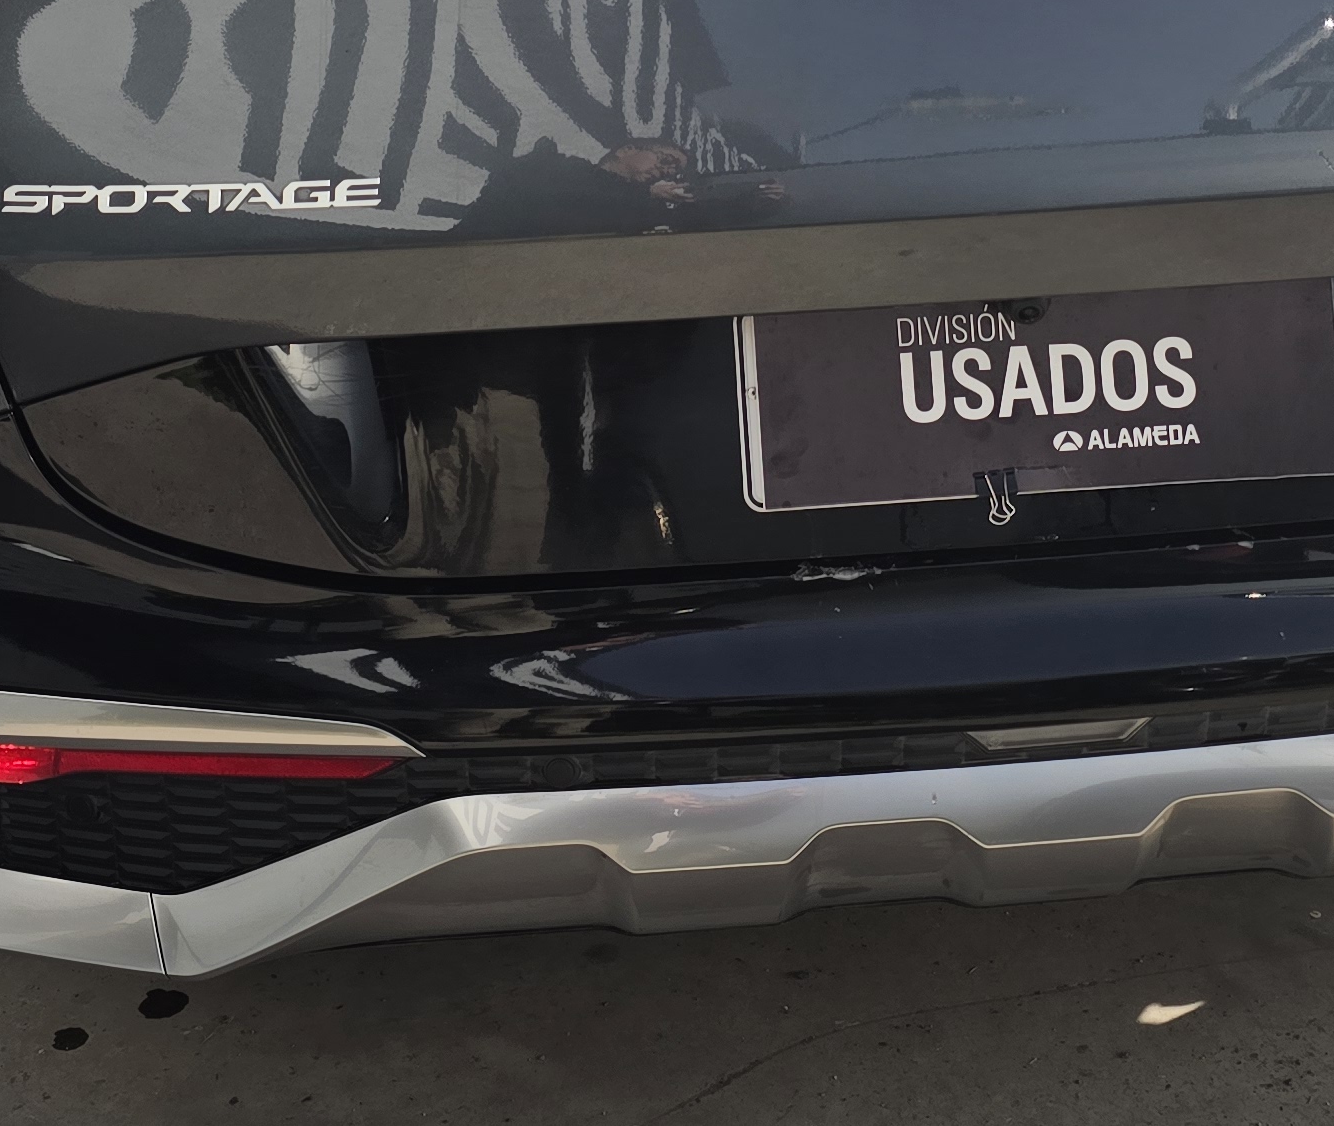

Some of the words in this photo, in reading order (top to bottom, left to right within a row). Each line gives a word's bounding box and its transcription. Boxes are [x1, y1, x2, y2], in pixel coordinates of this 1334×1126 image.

[1, 177, 382, 216] SPORTAGE
[896, 304, 1016, 347] DIVISIÓN
[899, 336, 1197, 423] USADOS
[1088, 423, 1201, 451] ALAMEDA
